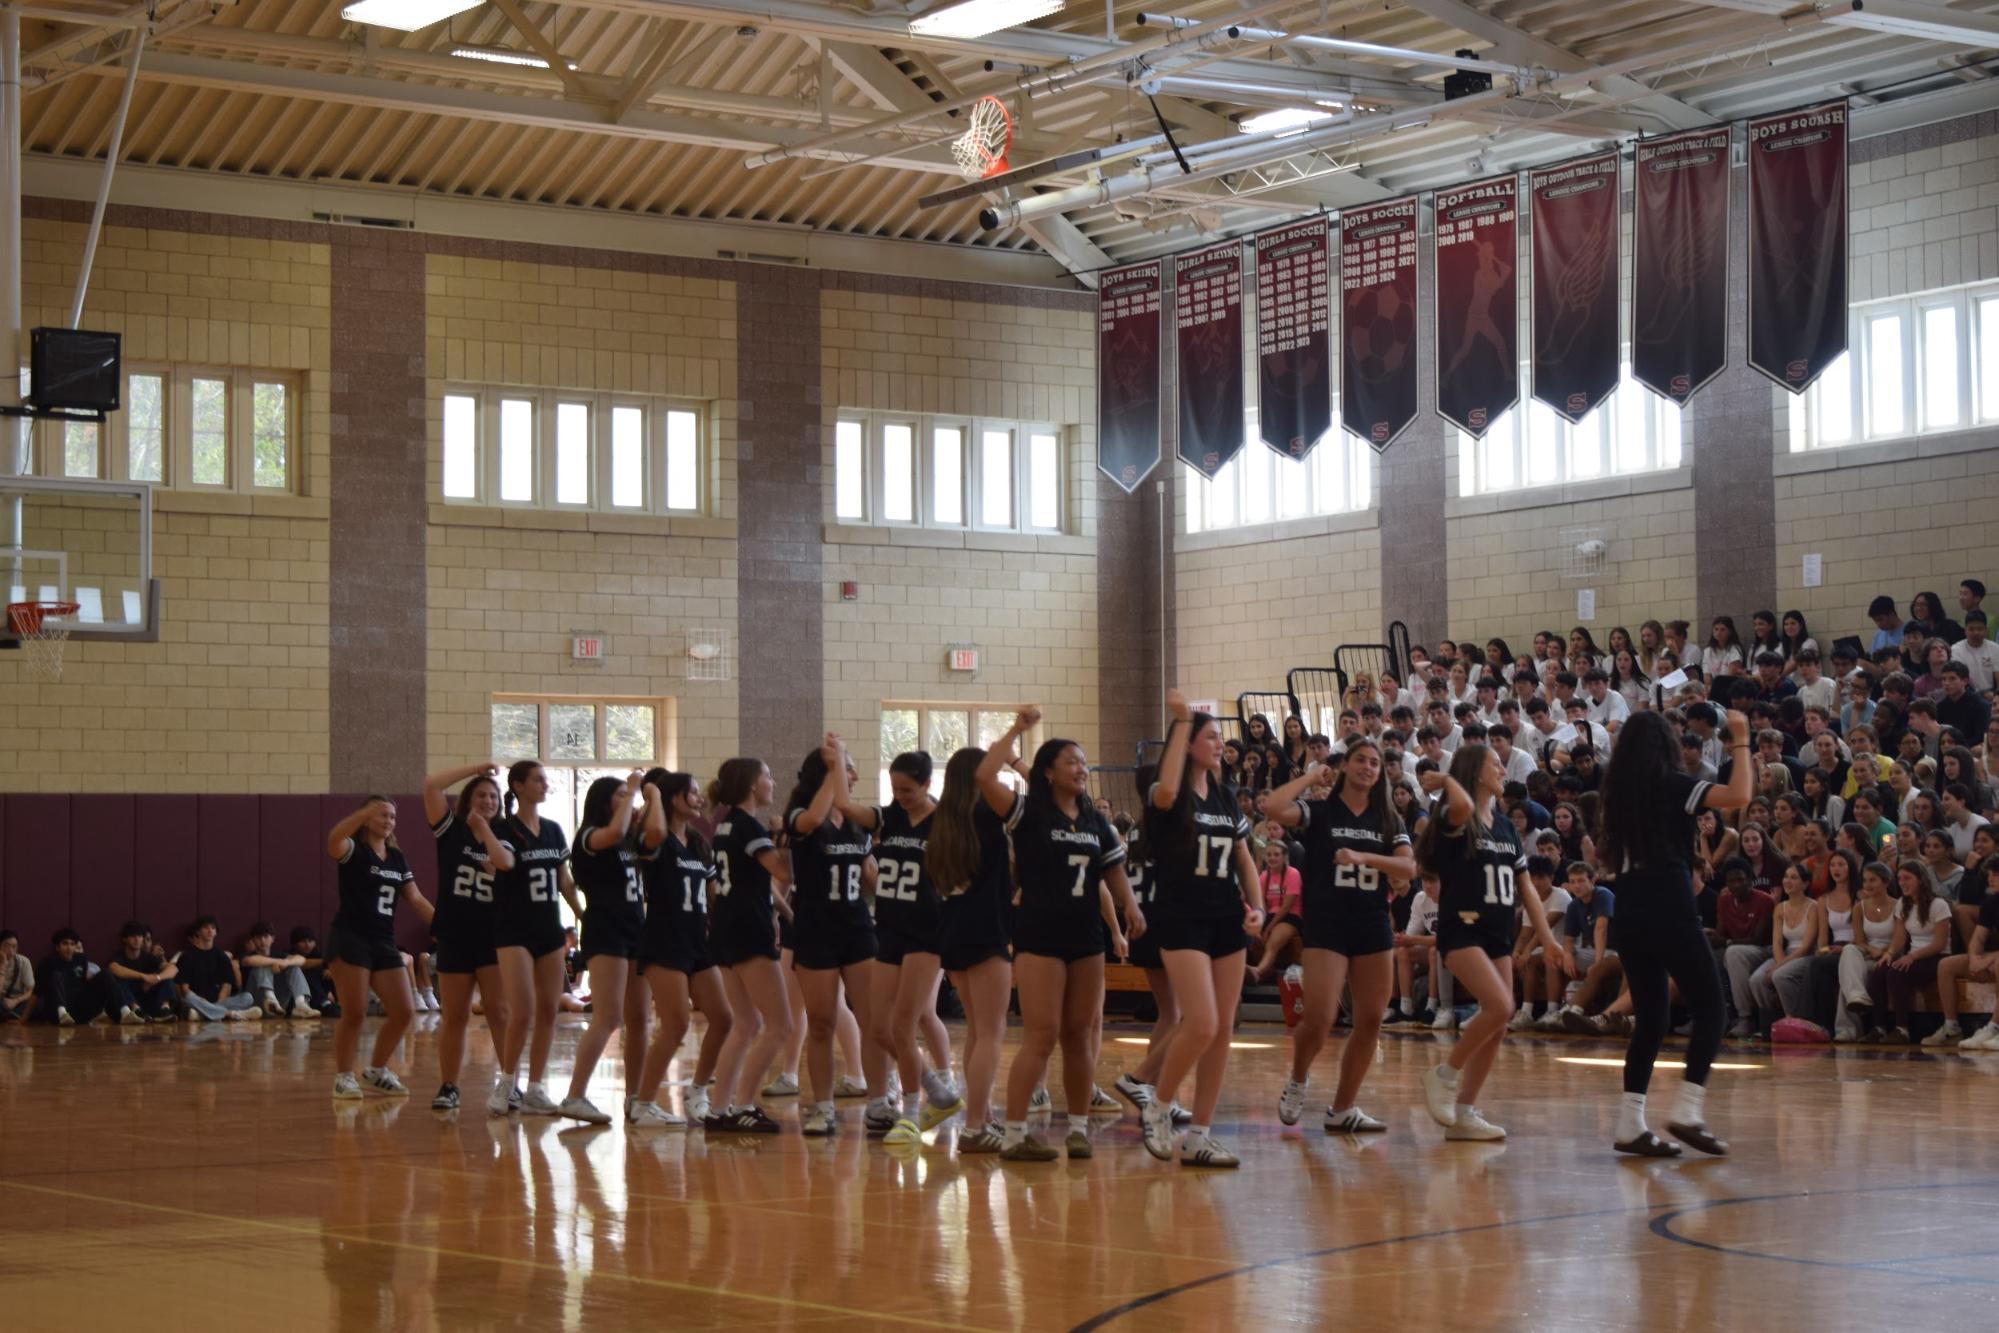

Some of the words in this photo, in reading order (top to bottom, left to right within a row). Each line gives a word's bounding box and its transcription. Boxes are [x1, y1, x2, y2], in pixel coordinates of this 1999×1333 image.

[1752, 122, 1786, 142] BOYS
[1791, 110, 1844, 129] SQUASH
[1548, 169, 1574, 184] OUTDOOR
[1438, 184, 1514, 210] SOFTBALL
[1344, 214, 1369, 230] BOYS
[1372, 204, 1414, 220] SOCCER
[1259, 234, 1286, 250] GIRLS
[1288, 224, 1324, 240] SOCCER
[1178, 255, 1204, 272] GIRLS
[1208, 246, 1240, 260] SKIING
[1399, 256, 1414, 266] 2021
[1102, 272, 1124, 288] BOYS
[1126, 266, 1158, 280] SKIING
[1344, 278, 1360, 290] 2022
[579, 640, 598, 656] EXIT
[1331, 828, 1384, 843] SCARSDALE
[1194, 834, 1233, 878] 17
[454, 864, 495, 902] 25
[529, 867, 560, 902] 21
[876, 857, 920, 902] 22
[1068, 854, 1090, 897] 7
[1483, 864, 1514, 906] 10
[378, 884, 396, 916] 2
[682, 876, 708, 914] 14
